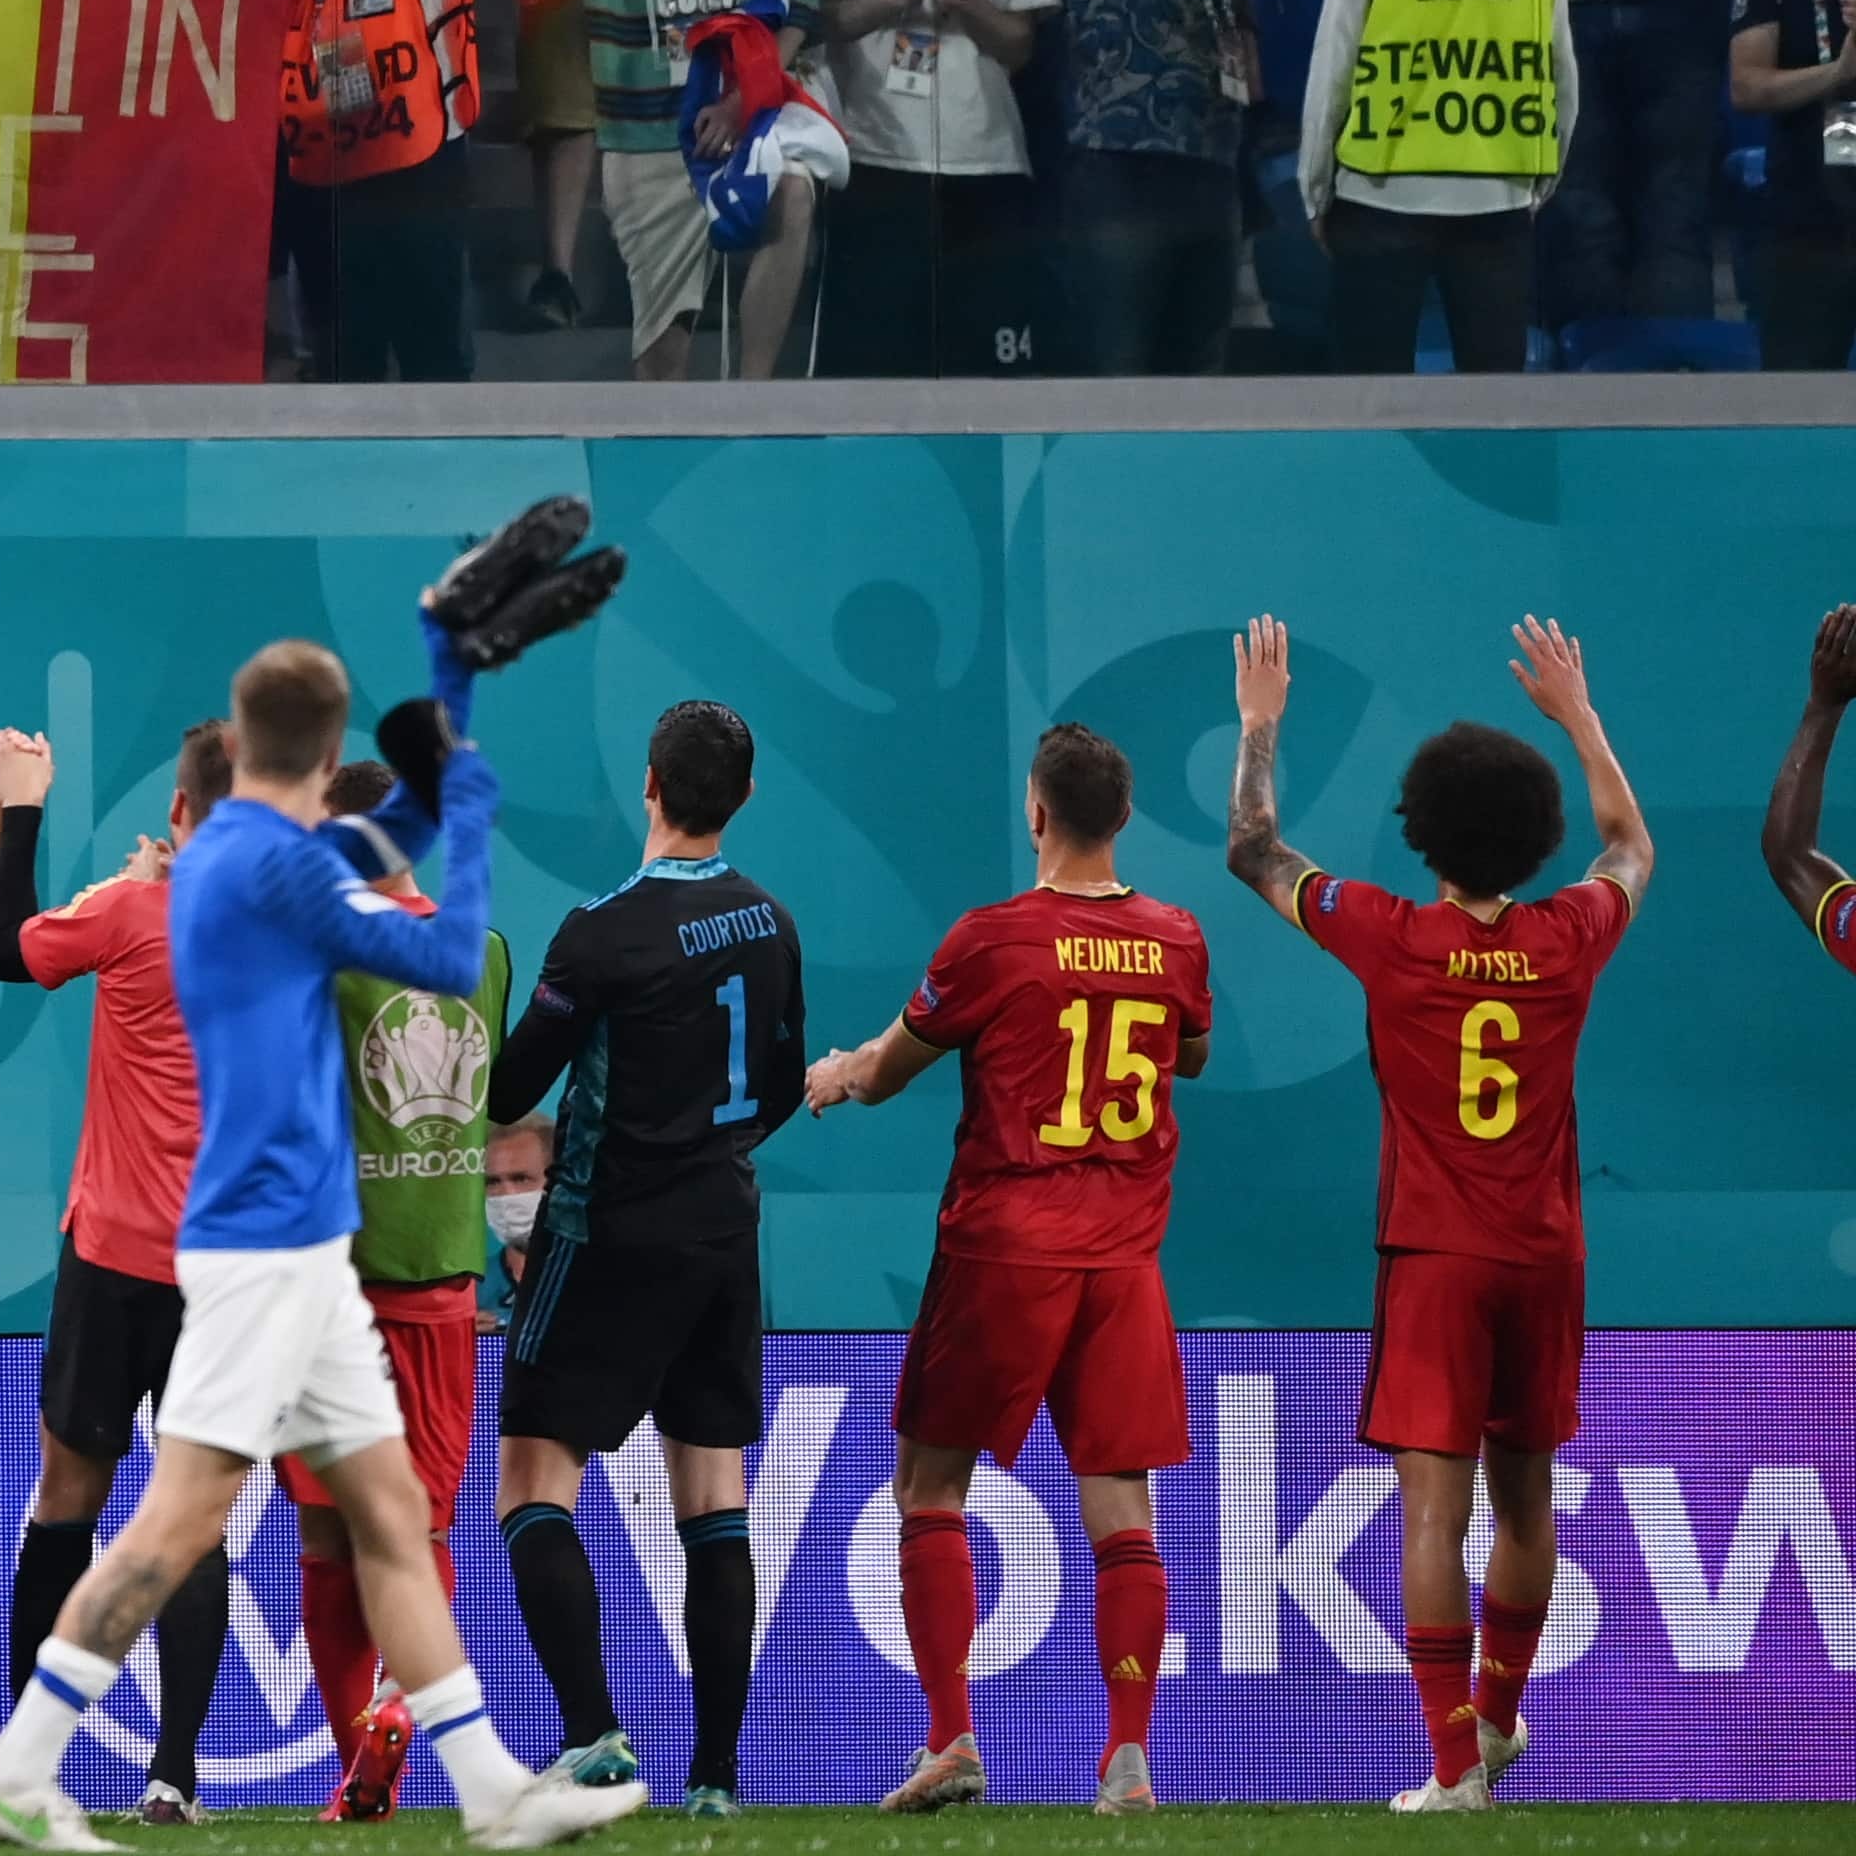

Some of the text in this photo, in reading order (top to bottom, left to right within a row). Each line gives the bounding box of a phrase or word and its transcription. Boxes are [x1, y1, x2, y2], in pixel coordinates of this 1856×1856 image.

[1353, 39, 1556, 85] STEWAR
[1351, 91, 1560, 142] 12-006
[676, 901, 779, 960] COURTOIS
[1053, 936, 1165, 976] MEUNIER
[1447, 950, 1540, 984] WITSEL
[712, 973, 759, 1127] 1
[1039, 998, 1168, 1147] 15
[1458, 999, 1520, 1141] 6
[406, 1121, 457, 1148] UEFA
[600, 1372, 1856, 1680] Vokw
